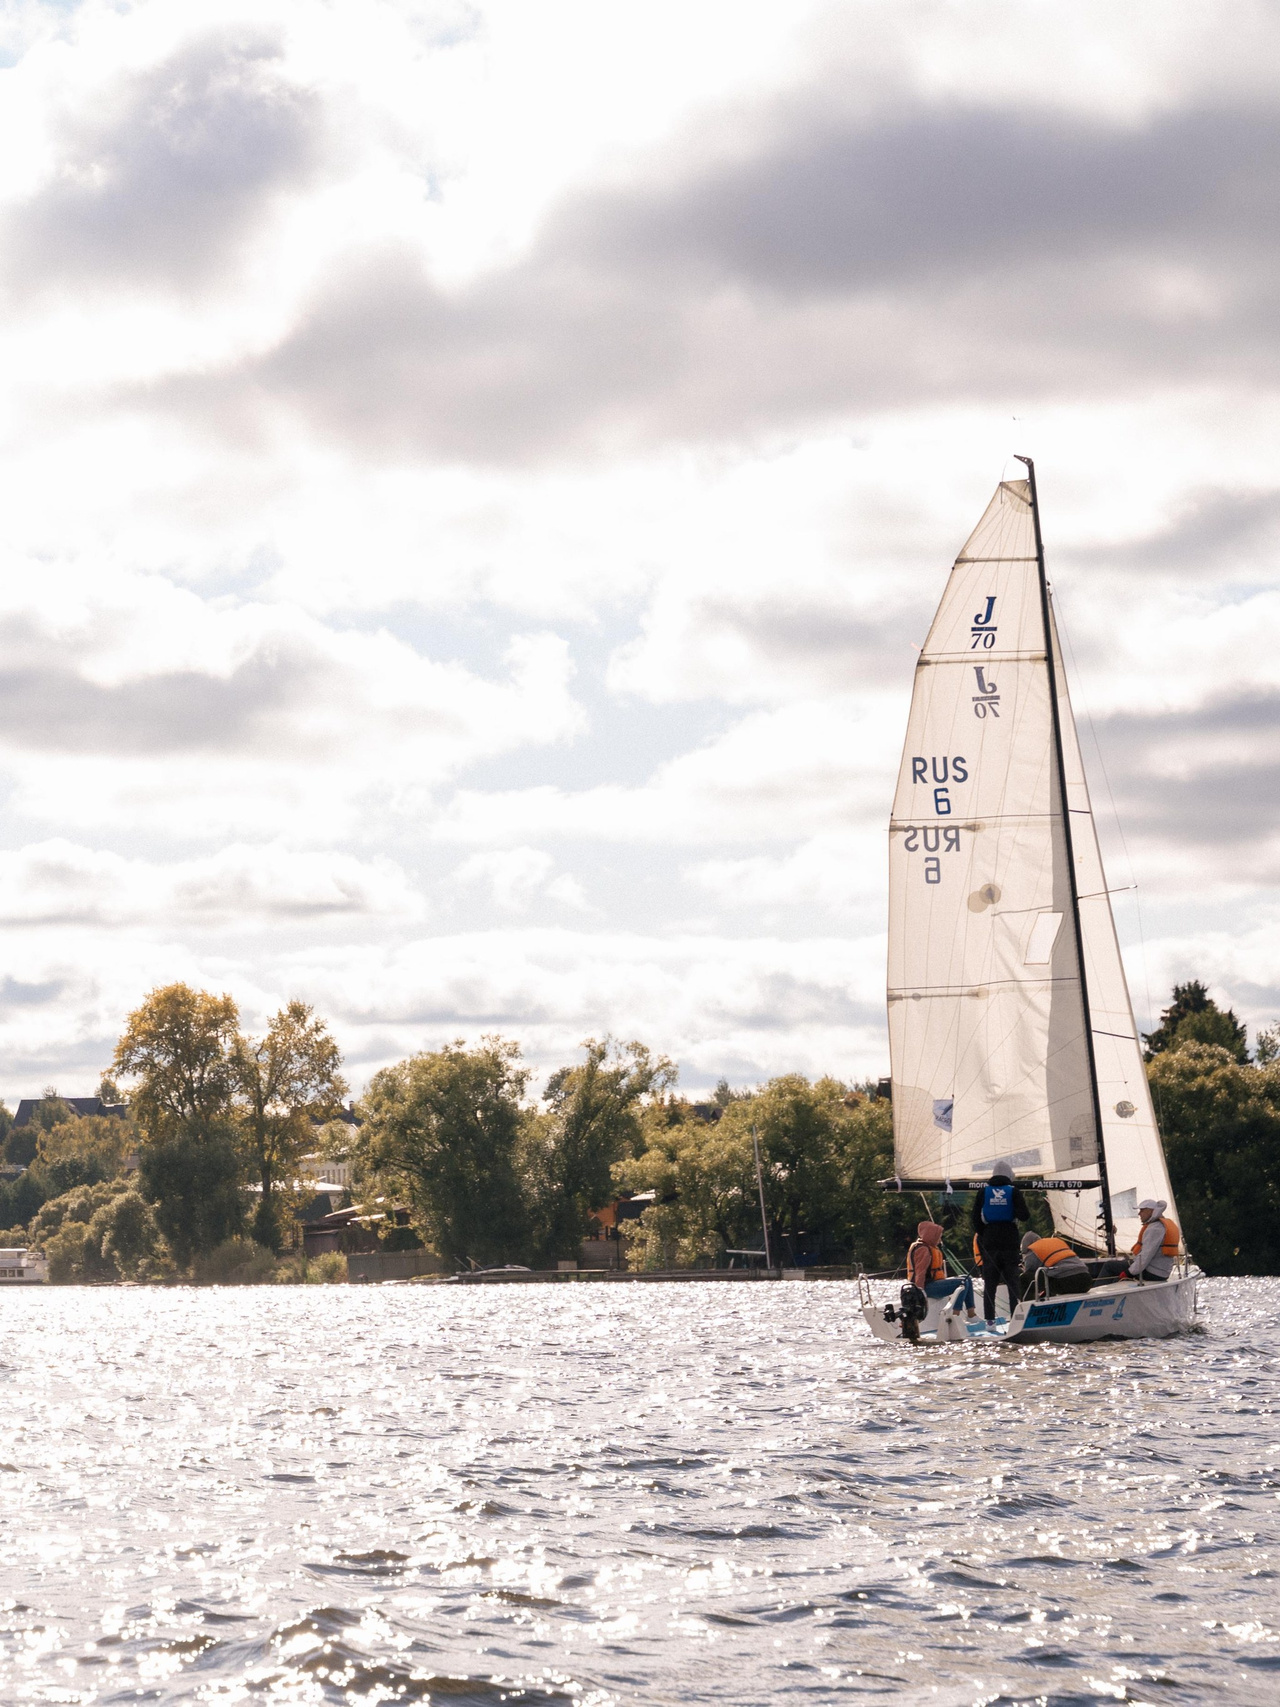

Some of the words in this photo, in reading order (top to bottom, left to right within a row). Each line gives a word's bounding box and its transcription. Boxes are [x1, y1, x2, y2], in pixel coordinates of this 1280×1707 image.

[974, 597, 997, 625] J
[971, 633, 995, 649] 70
[912, 757, 968, 784] RUS
[934, 788, 951, 815] 6
